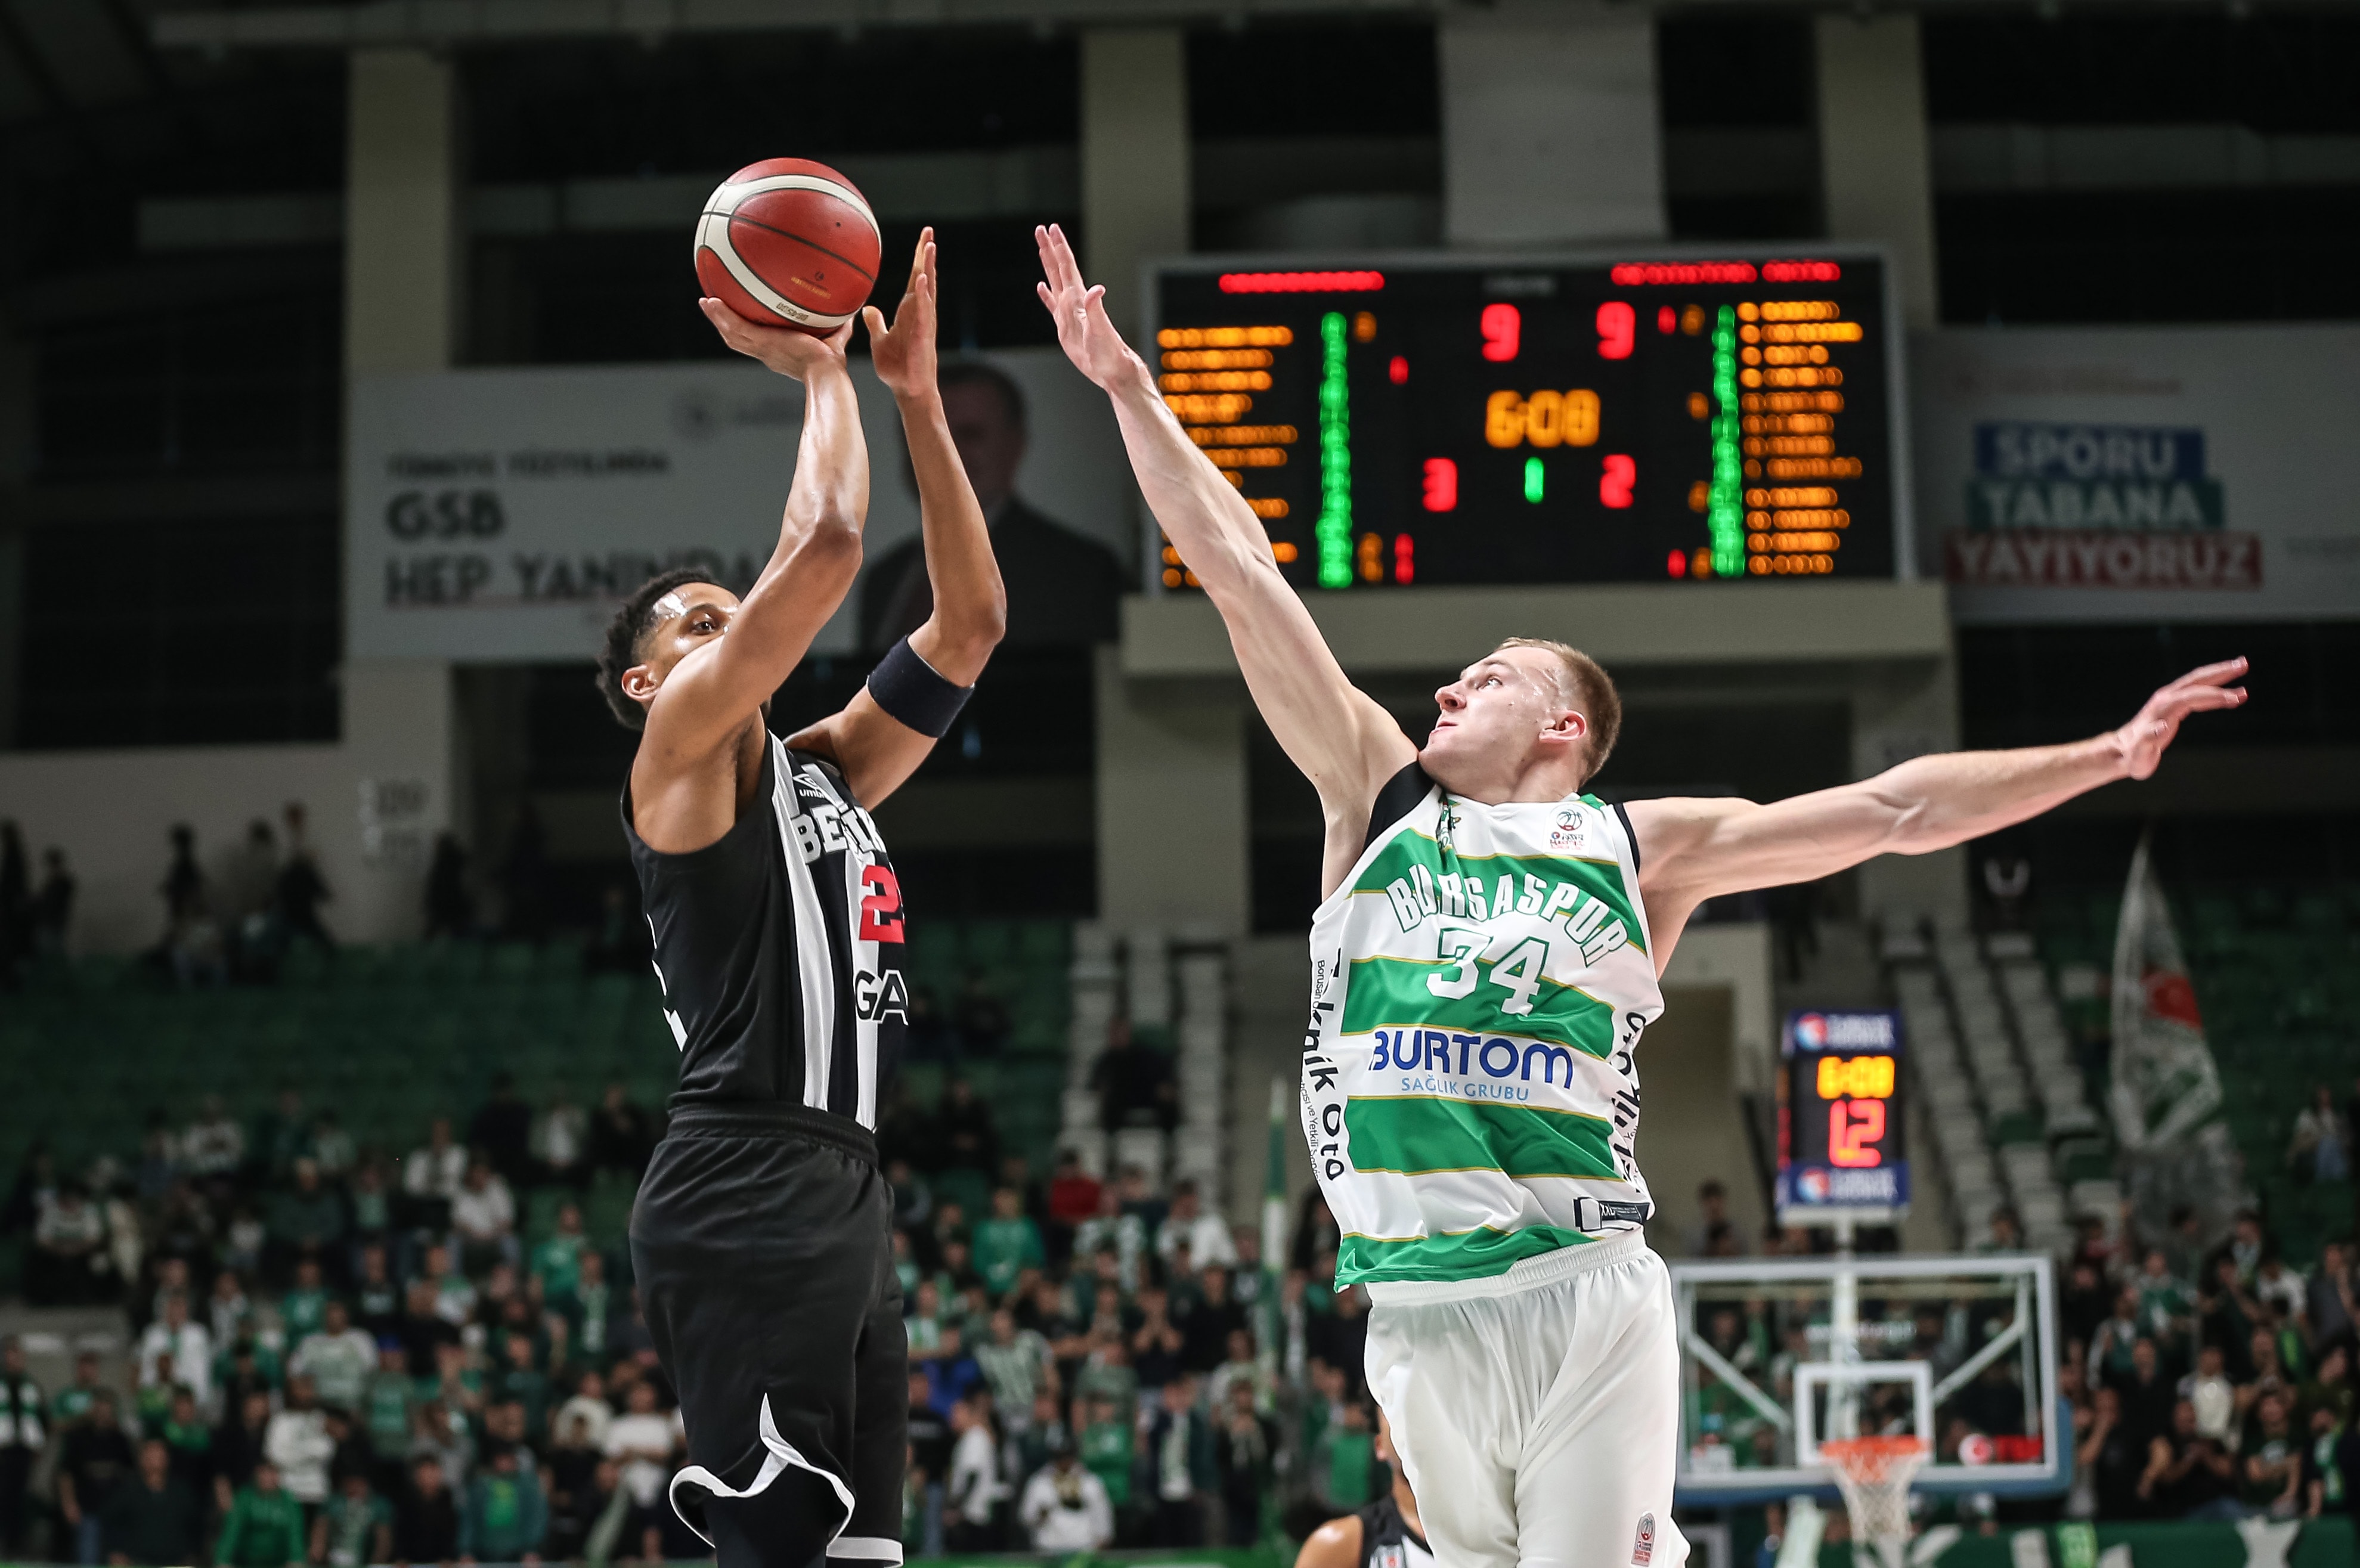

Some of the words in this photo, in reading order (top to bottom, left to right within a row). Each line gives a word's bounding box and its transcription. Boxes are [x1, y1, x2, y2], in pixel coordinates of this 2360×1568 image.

[1481, 303, 1520, 362] 9
[1596, 301, 1636, 360] 9
[1485, 389, 1600, 448] 6:08
[1994, 428, 2178, 476] SPORU
[1423, 457, 1458, 512] 3
[1600, 454, 1636, 509] 2
[1983, 482, 2204, 526] TABANA
[386, 490, 507, 540] GSB
[386, 553, 492, 604] HEP
[1954, 535, 2252, 581] YAYIYORUZ
[1386, 863, 1628, 968] BURSASPOR
[1314, 960, 1325, 999] Borusan
[1426, 927, 1551, 1017] 34
[1368, 1030, 1574, 1090] BURTOM
[1401, 1074, 1459, 1095] SAĞLIK
[1464, 1083, 1529, 1101] GRUBU
[1309, 1117, 1319, 1147] Yetkili
[1829, 1099, 1885, 1168] 12
